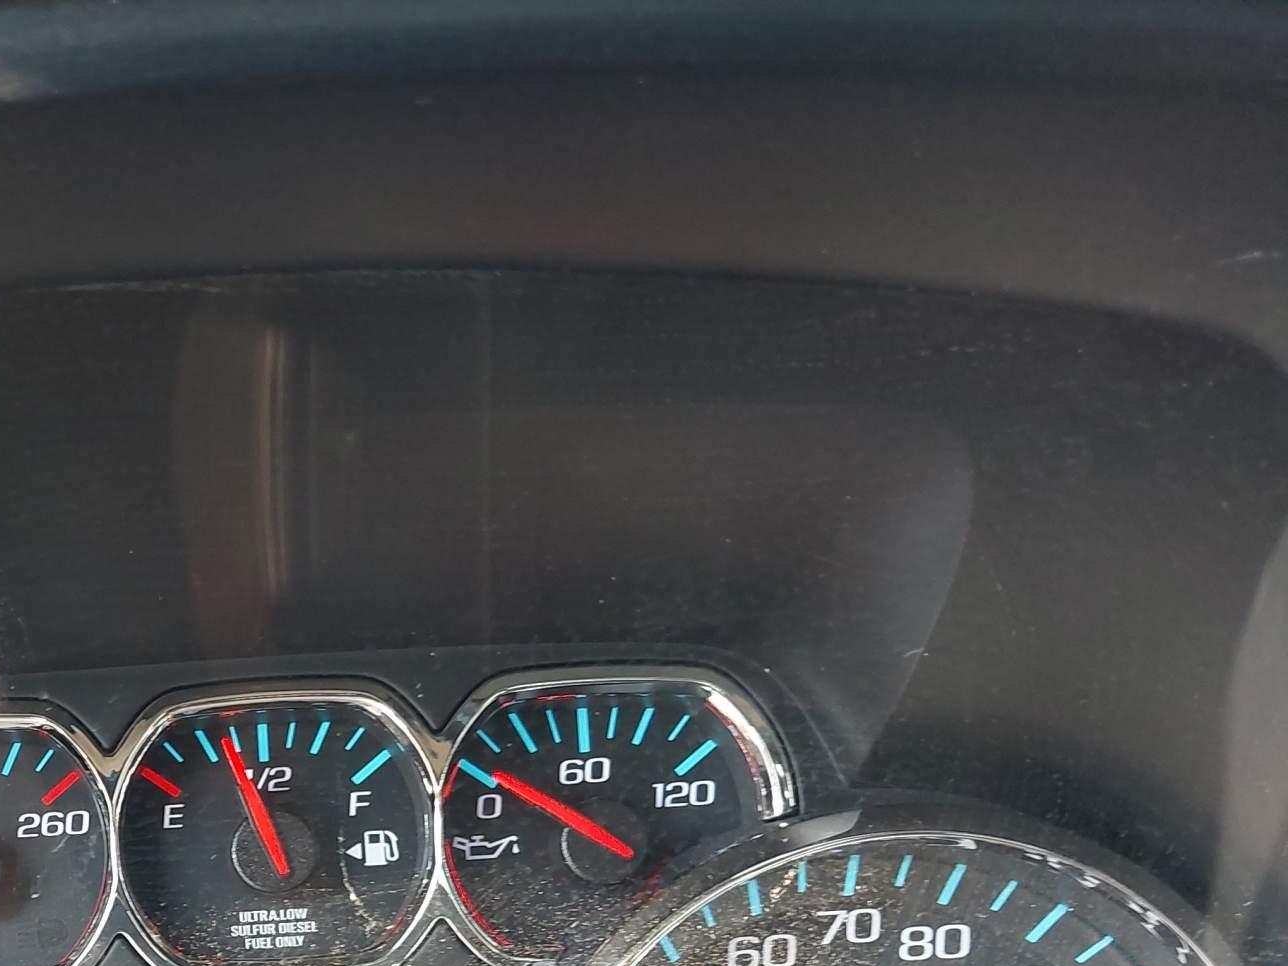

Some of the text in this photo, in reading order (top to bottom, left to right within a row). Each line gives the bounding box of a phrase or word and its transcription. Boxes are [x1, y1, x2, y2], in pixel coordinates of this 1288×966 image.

[559, 757, 611, 785] 60
[348, 791, 372, 817] F
[477, 794, 502, 819] 0
[652, 780, 716, 808] 120
[16, 810, 90, 838] 260
[162, 803, 185, 829] E
[230, 920, 318, 937] SULFUR DIESEL
[816, 908, 882, 945] 70
[244, 935, 305, 950] FUEL ONLY
[898, 925, 971, 961] 80
